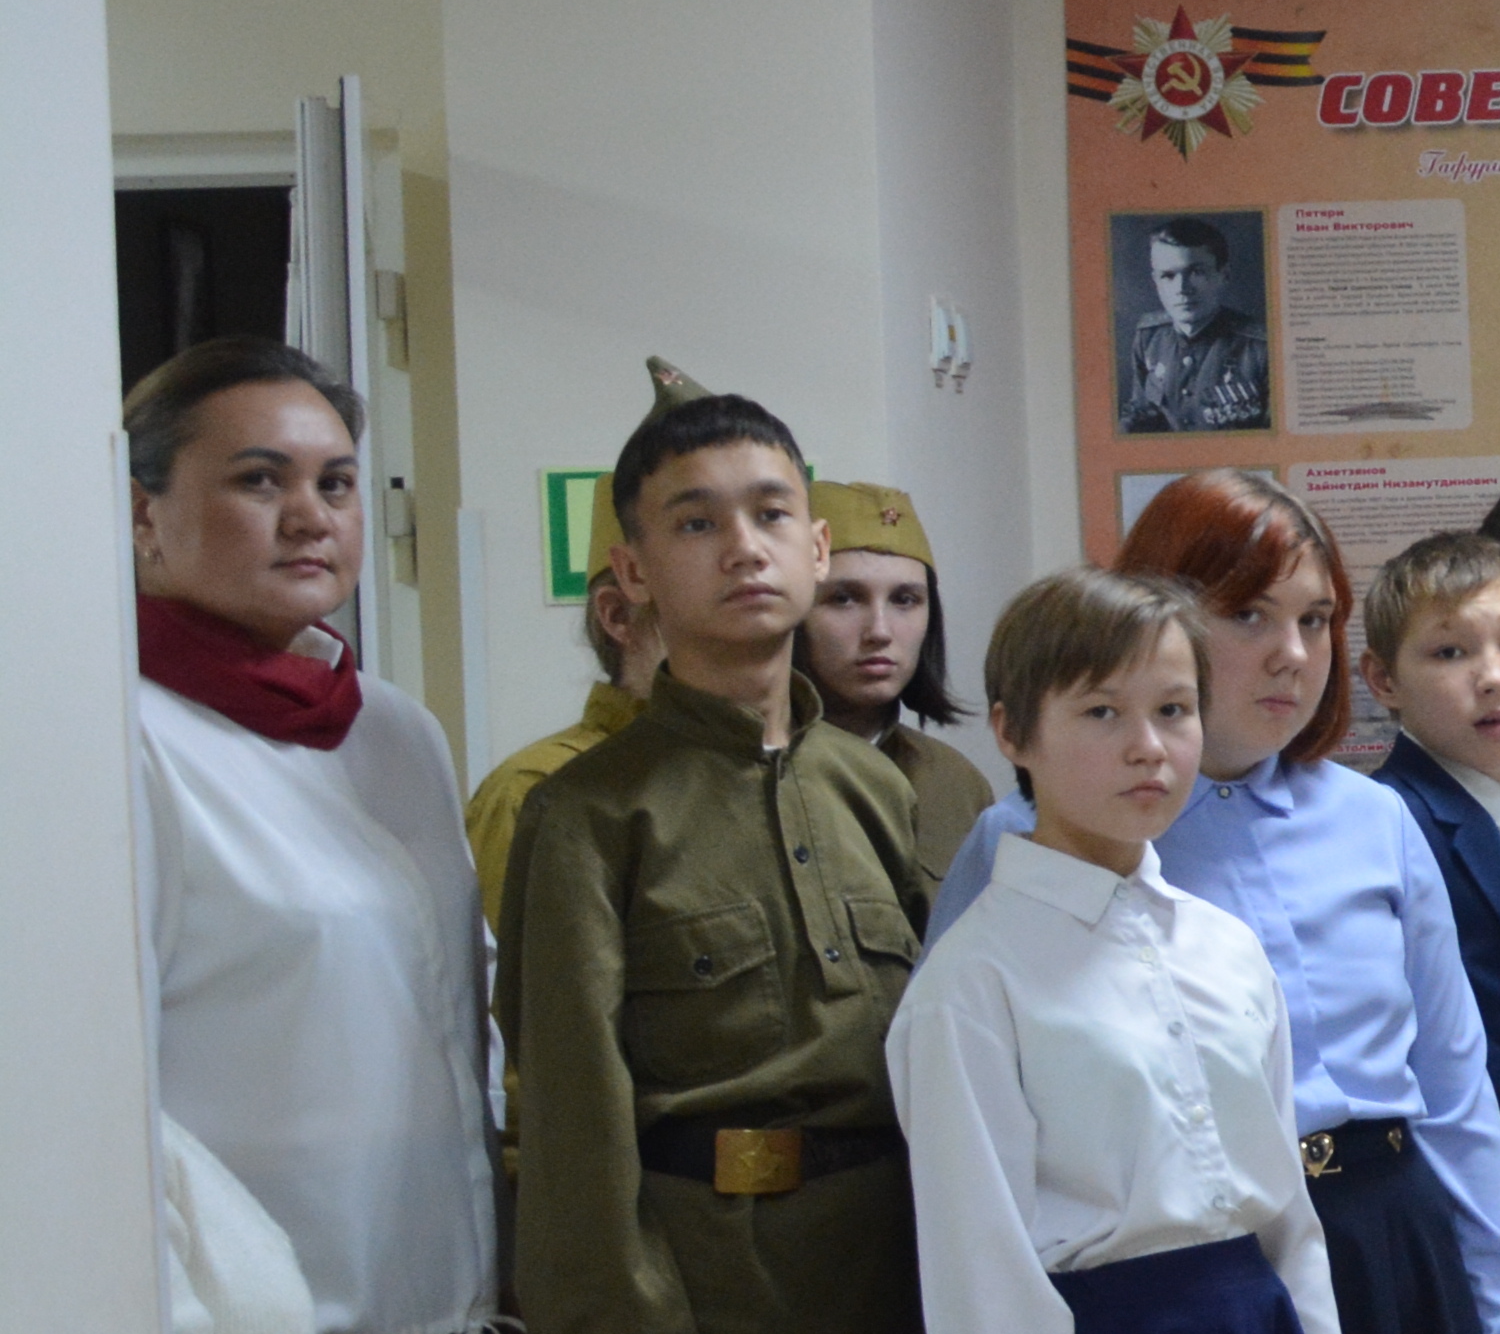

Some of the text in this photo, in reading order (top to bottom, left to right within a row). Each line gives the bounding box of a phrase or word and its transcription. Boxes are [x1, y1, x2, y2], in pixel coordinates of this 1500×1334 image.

[1334, 222, 1414, 231] Викторович
[1306, 467, 1386, 477] Ахметзянов
[1307, 478, 1498, 491] Зайнетдин Низамутдинович
